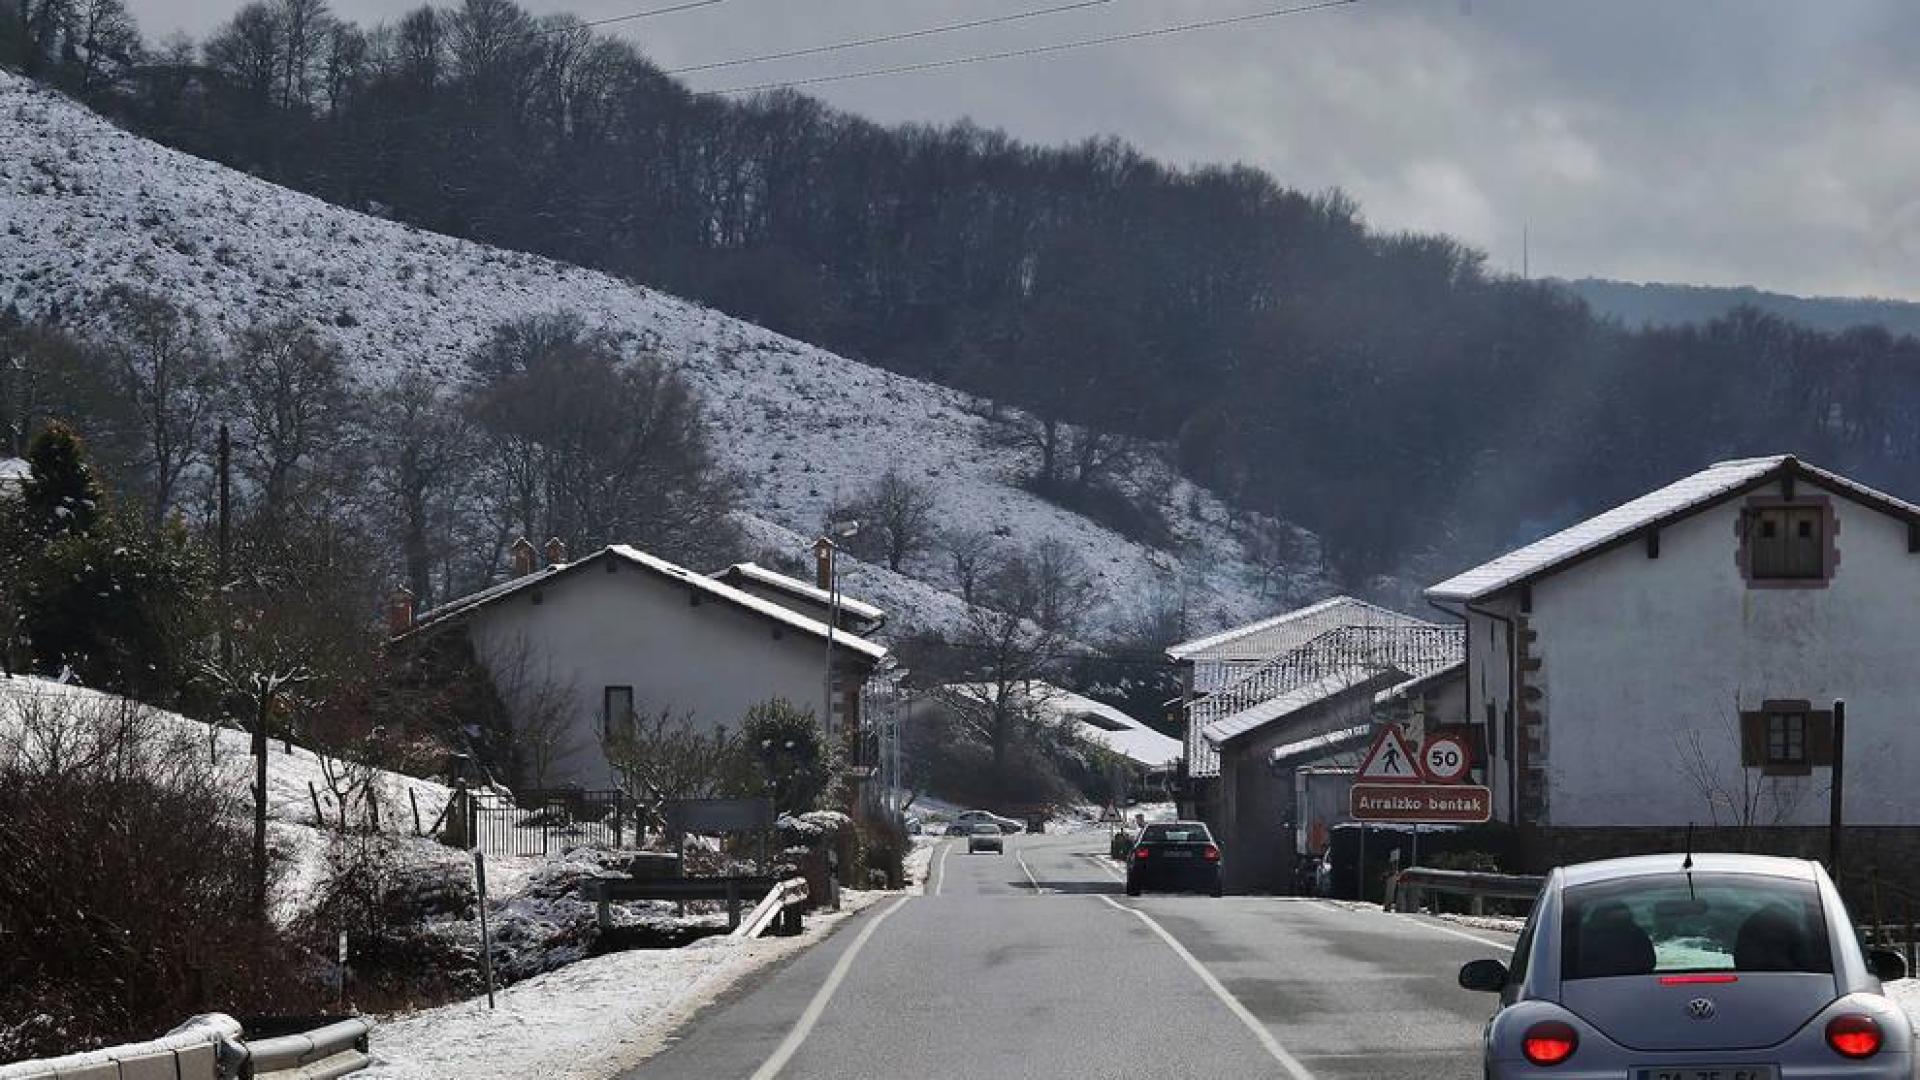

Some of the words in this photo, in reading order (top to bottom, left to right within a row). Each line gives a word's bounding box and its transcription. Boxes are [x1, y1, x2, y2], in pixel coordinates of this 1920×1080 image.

[1432, 751, 1458, 766] 50
[1359, 796, 1422, 810] Arraizko
[1428, 798, 1481, 811] bentak
